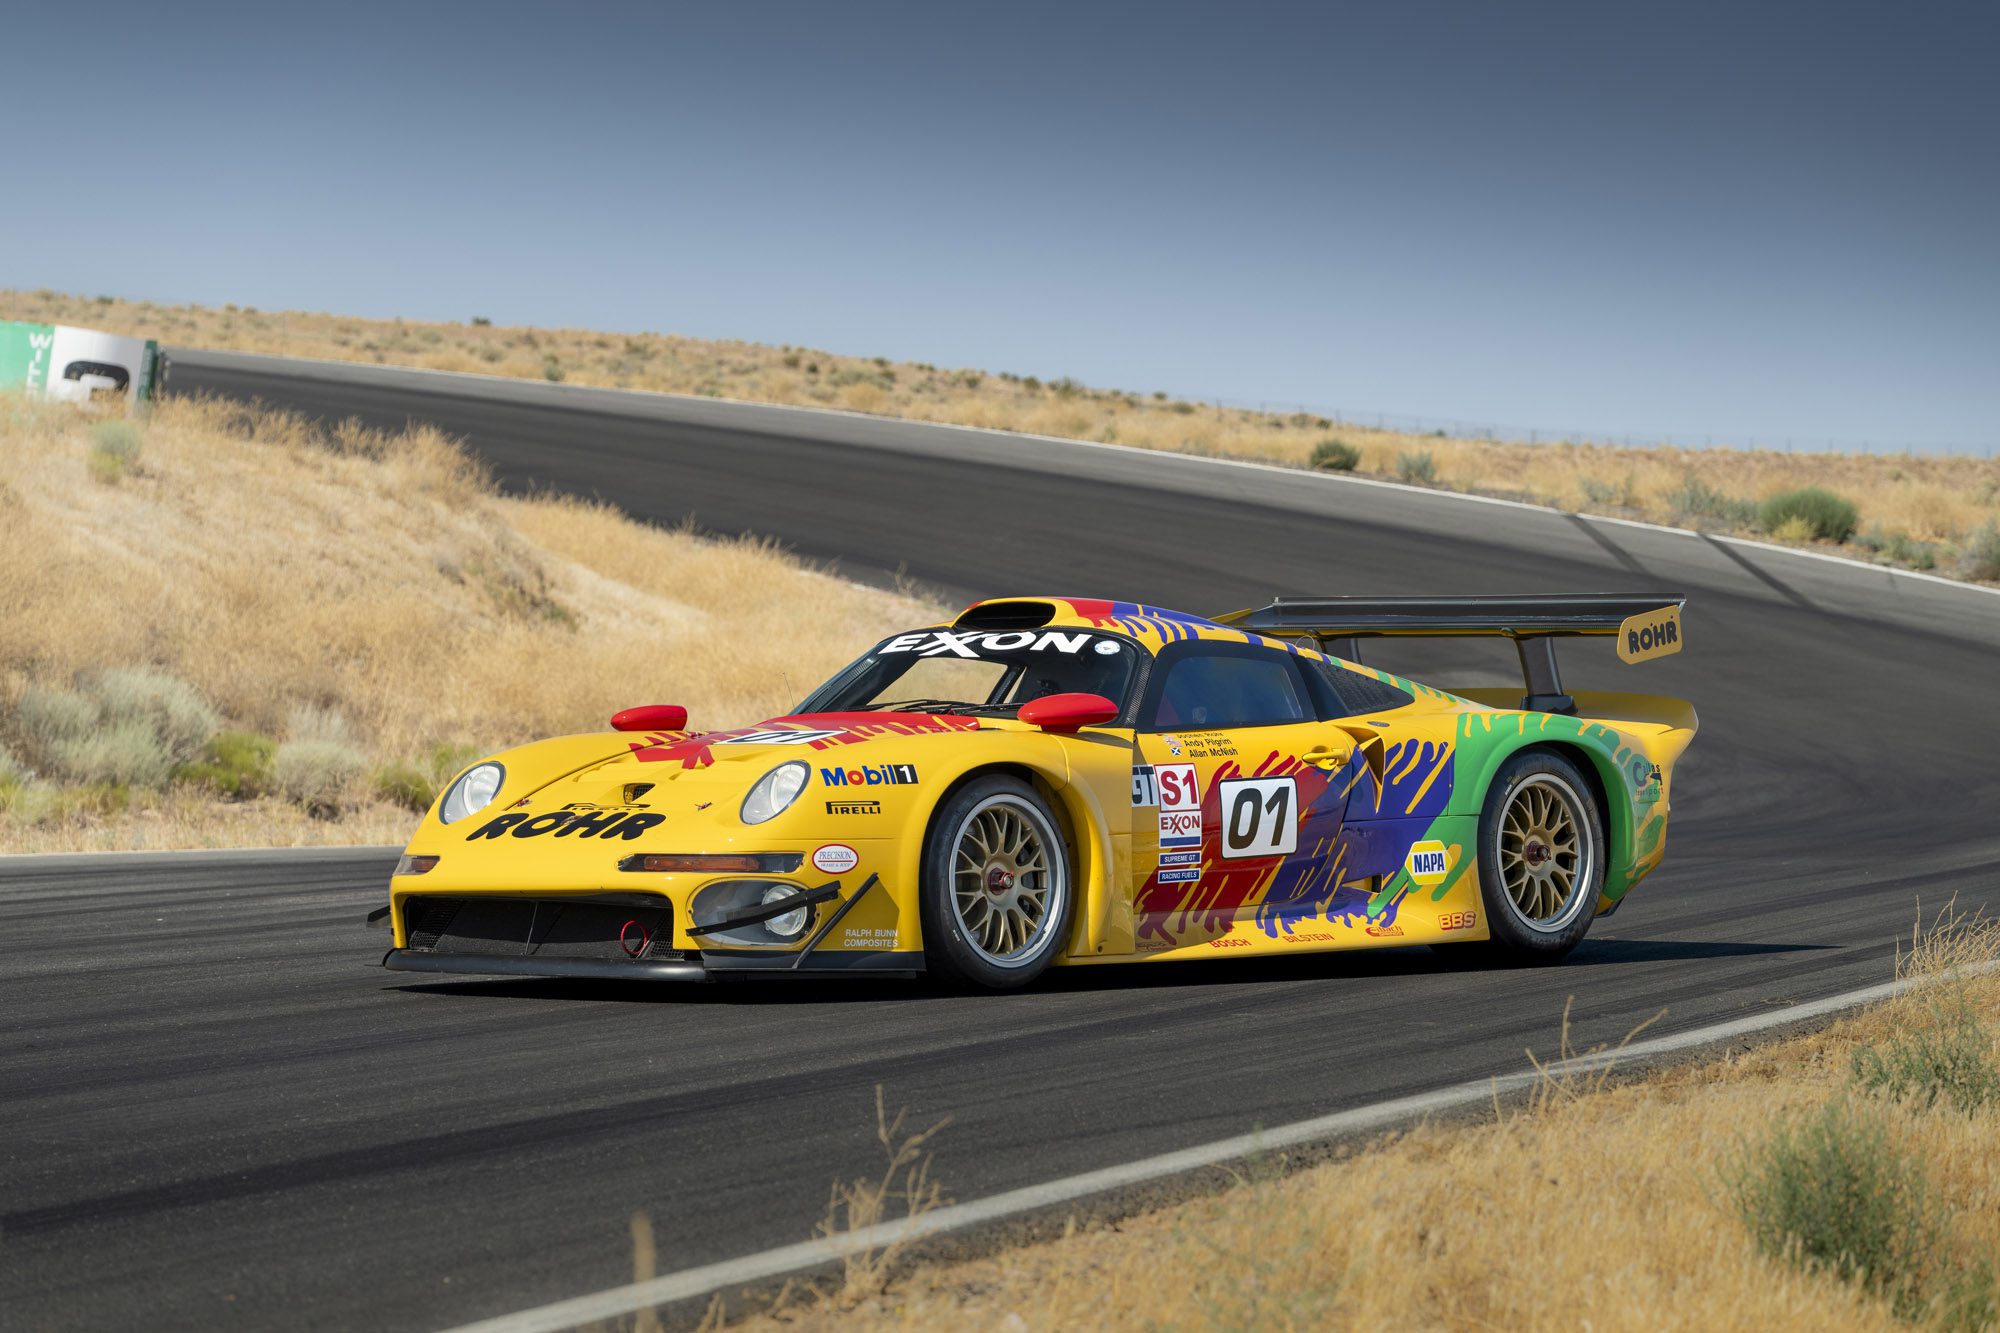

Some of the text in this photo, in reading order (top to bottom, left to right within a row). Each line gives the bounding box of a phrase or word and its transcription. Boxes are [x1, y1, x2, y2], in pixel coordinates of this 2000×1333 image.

[1628, 621, 1678, 654] ROHR
[878, 631, 1093, 658] EXXON
[1184, 738, 1233, 748] Andy Pilgrim
[1189, 747, 1239, 758] Allan McNish
[1160, 769, 1199, 806] S1
[826, 800, 881, 815] PIRELLI
[1161, 813, 1201, 835] EXXON
[1228, 786, 1290, 850] 01
[466, 811, 667, 842] ROHR
[819, 850, 852, 860] PRECISION
[1164, 854, 1196, 863] SUPREME GT
[1413, 852, 1445, 873] NAPA
[1162, 871, 1197, 880] RACING FUELS
[1438, 911, 1477, 931] BBS
[845, 928, 898, 938] RALPH BUNN
[1282, 933, 1336, 943] BILSTEIN
[844, 938, 899, 948] COMPOSITES
[1208, 938, 1252, 948] BOSCH
